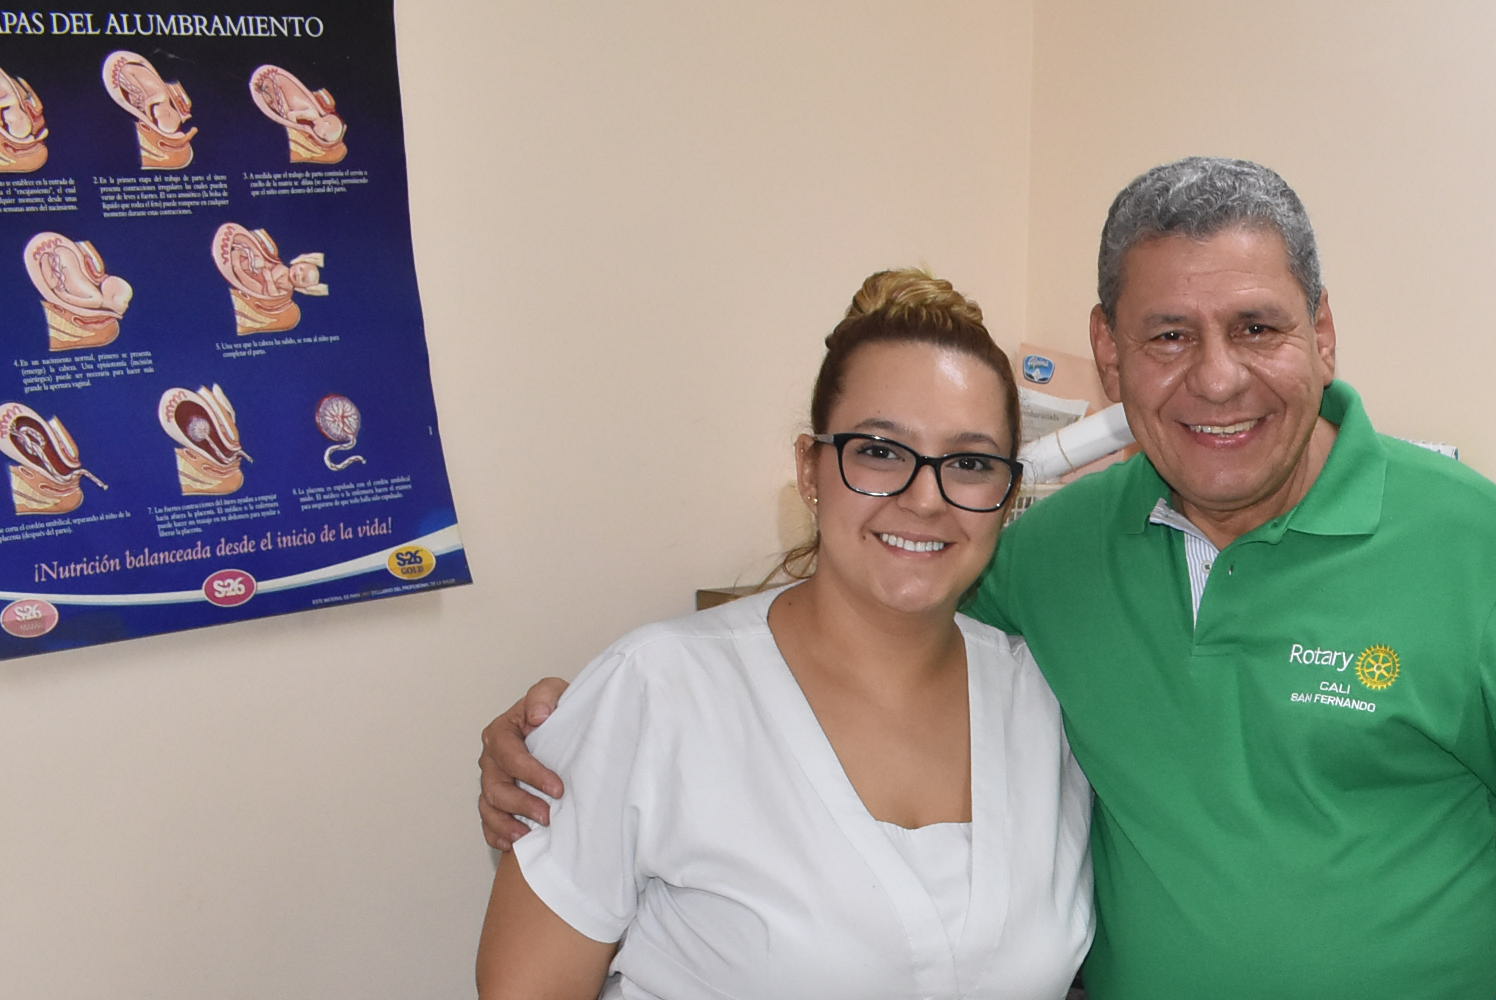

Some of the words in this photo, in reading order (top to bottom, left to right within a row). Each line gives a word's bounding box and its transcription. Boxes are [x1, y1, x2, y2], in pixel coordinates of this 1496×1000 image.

[50, 12, 100, 35] DEL
[105, 13, 324, 37] ALUMBRAMIENTO
[34, 554, 120, 583] ¡Nutrición
[125, 541, 211, 570] balanceada
[216, 532, 256, 557] desde
[260, 532, 272, 551] el
[277, 527, 316, 548] inicio
[320, 524, 336, 543] de
[340, 522, 353, 540] la
[358, 517, 392, 537] vida!
[400, 565, 424, 577] GOLD
[1289, 643, 1354, 672] Rotary
[1320, 681, 1351, 694] CALI
[1290, 692, 1312, 703] SAN
[1314, 694, 1376, 712] FERNANDO
